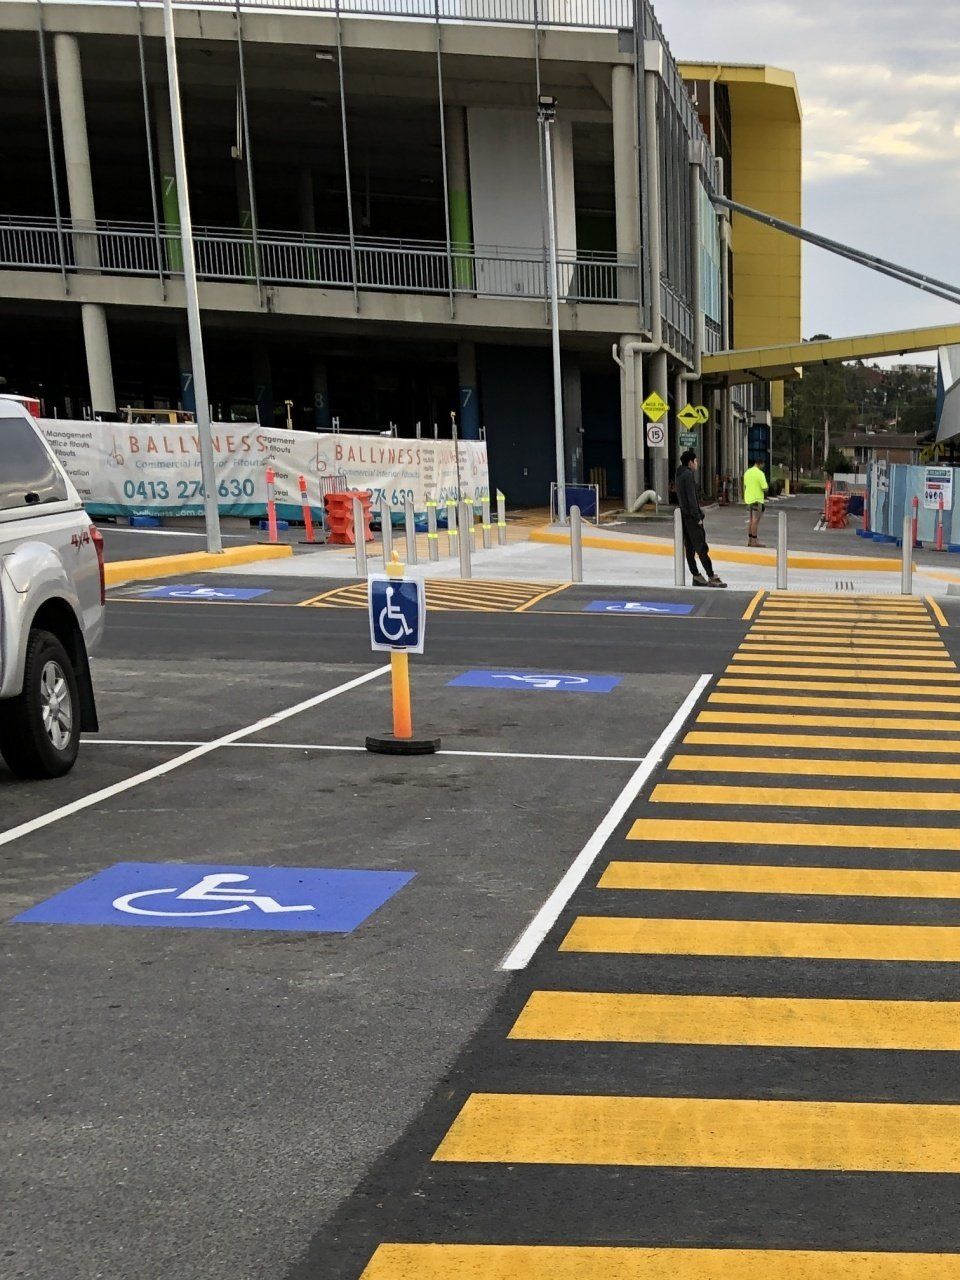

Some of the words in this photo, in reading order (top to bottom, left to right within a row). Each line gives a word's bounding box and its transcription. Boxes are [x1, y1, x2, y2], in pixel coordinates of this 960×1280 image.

[182, 373, 193, 391] 7
[462, 389, 472, 407] 7
[652, 431, 660, 440] 15
[335, 444, 421, 465] BALLYNESS
[124, 480, 170, 500] 0413
[218, 479, 255, 498] 630
